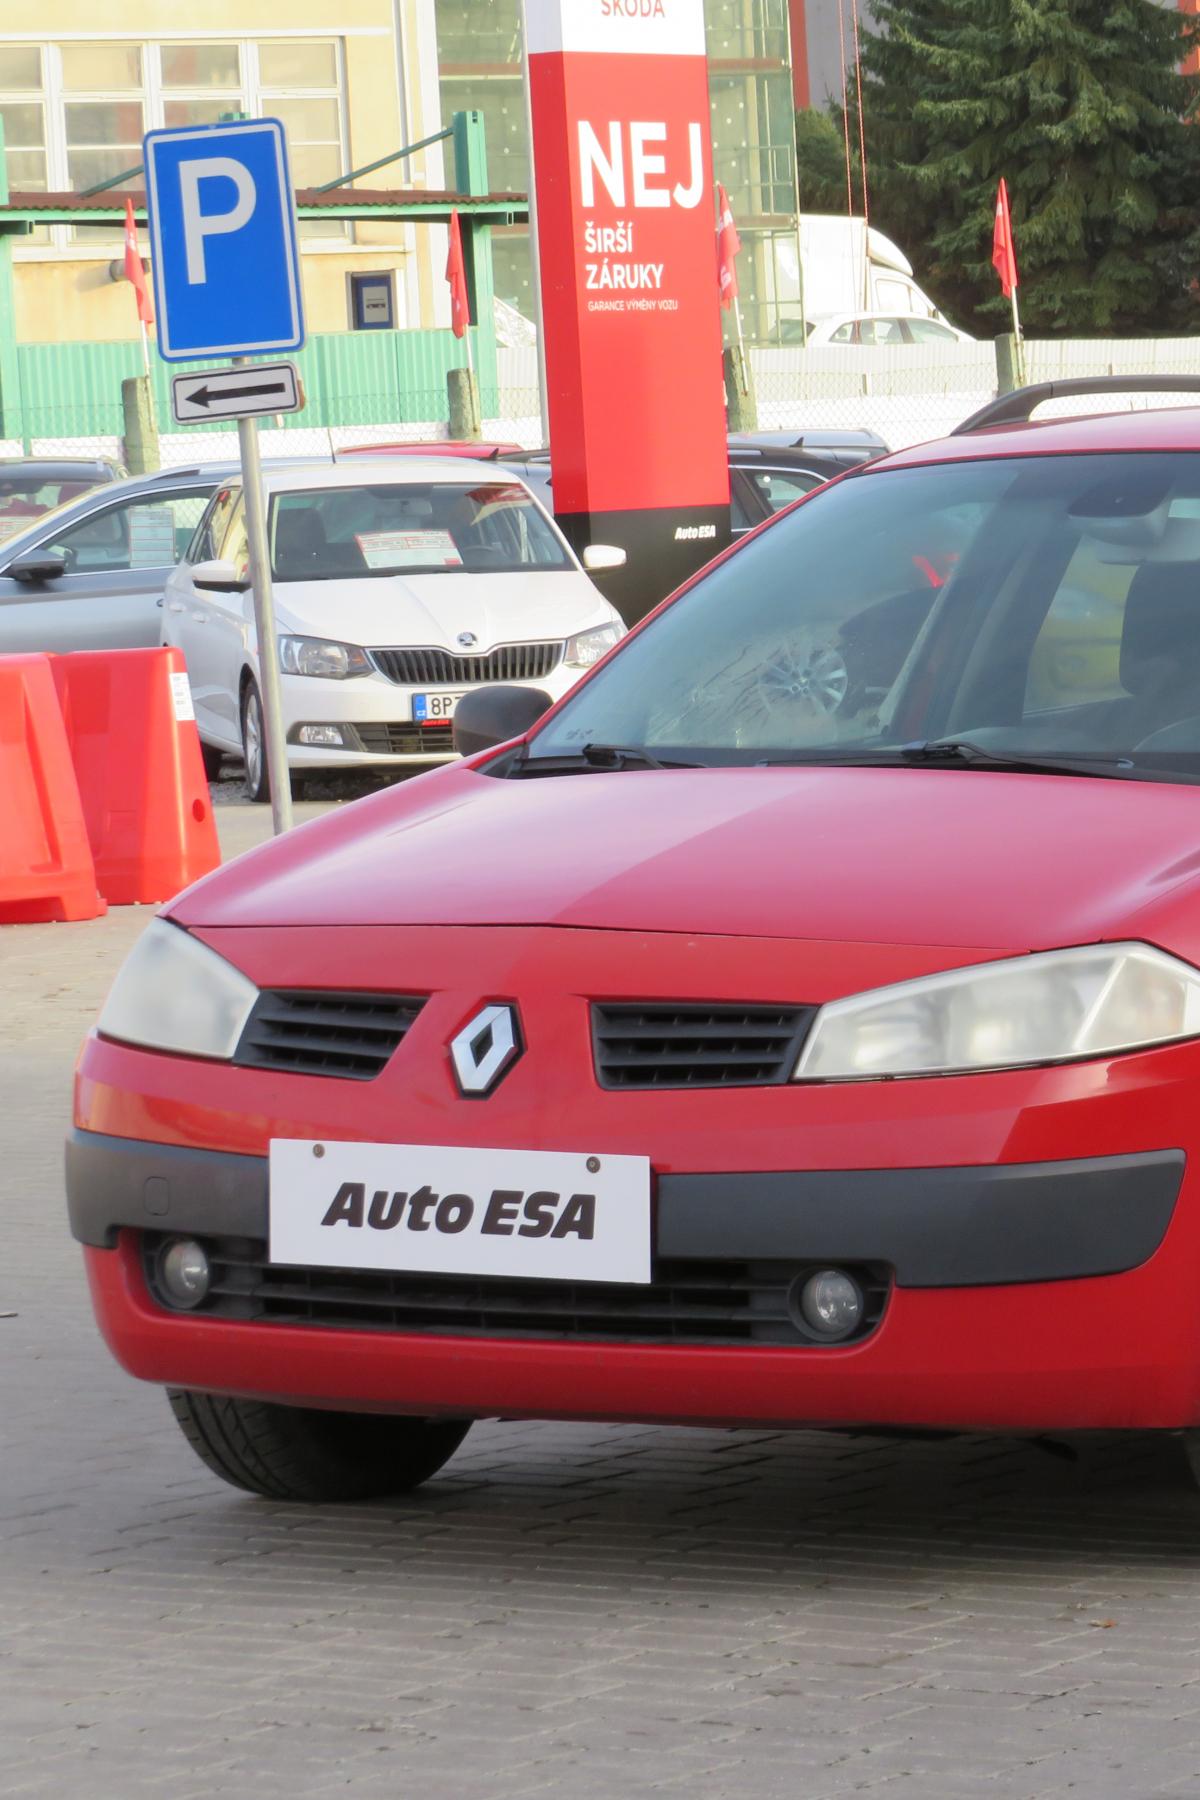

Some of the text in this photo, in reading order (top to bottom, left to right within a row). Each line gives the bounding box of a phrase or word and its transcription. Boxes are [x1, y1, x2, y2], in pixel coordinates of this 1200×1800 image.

[578, 120, 703, 208] NEJ
[178, 156, 257, 285] P
[585, 221, 633, 253] ŠIRŠÍ
[585, 257, 664, 289] ZÁRUKY
[588, 298, 678, 312] GARANCE VÝMĚNY VOZU
[675, 525, 716, 540] Auto ESA
[431, 696, 464, 716] 8P
[320, 1182, 597, 1240] Auto ESA
